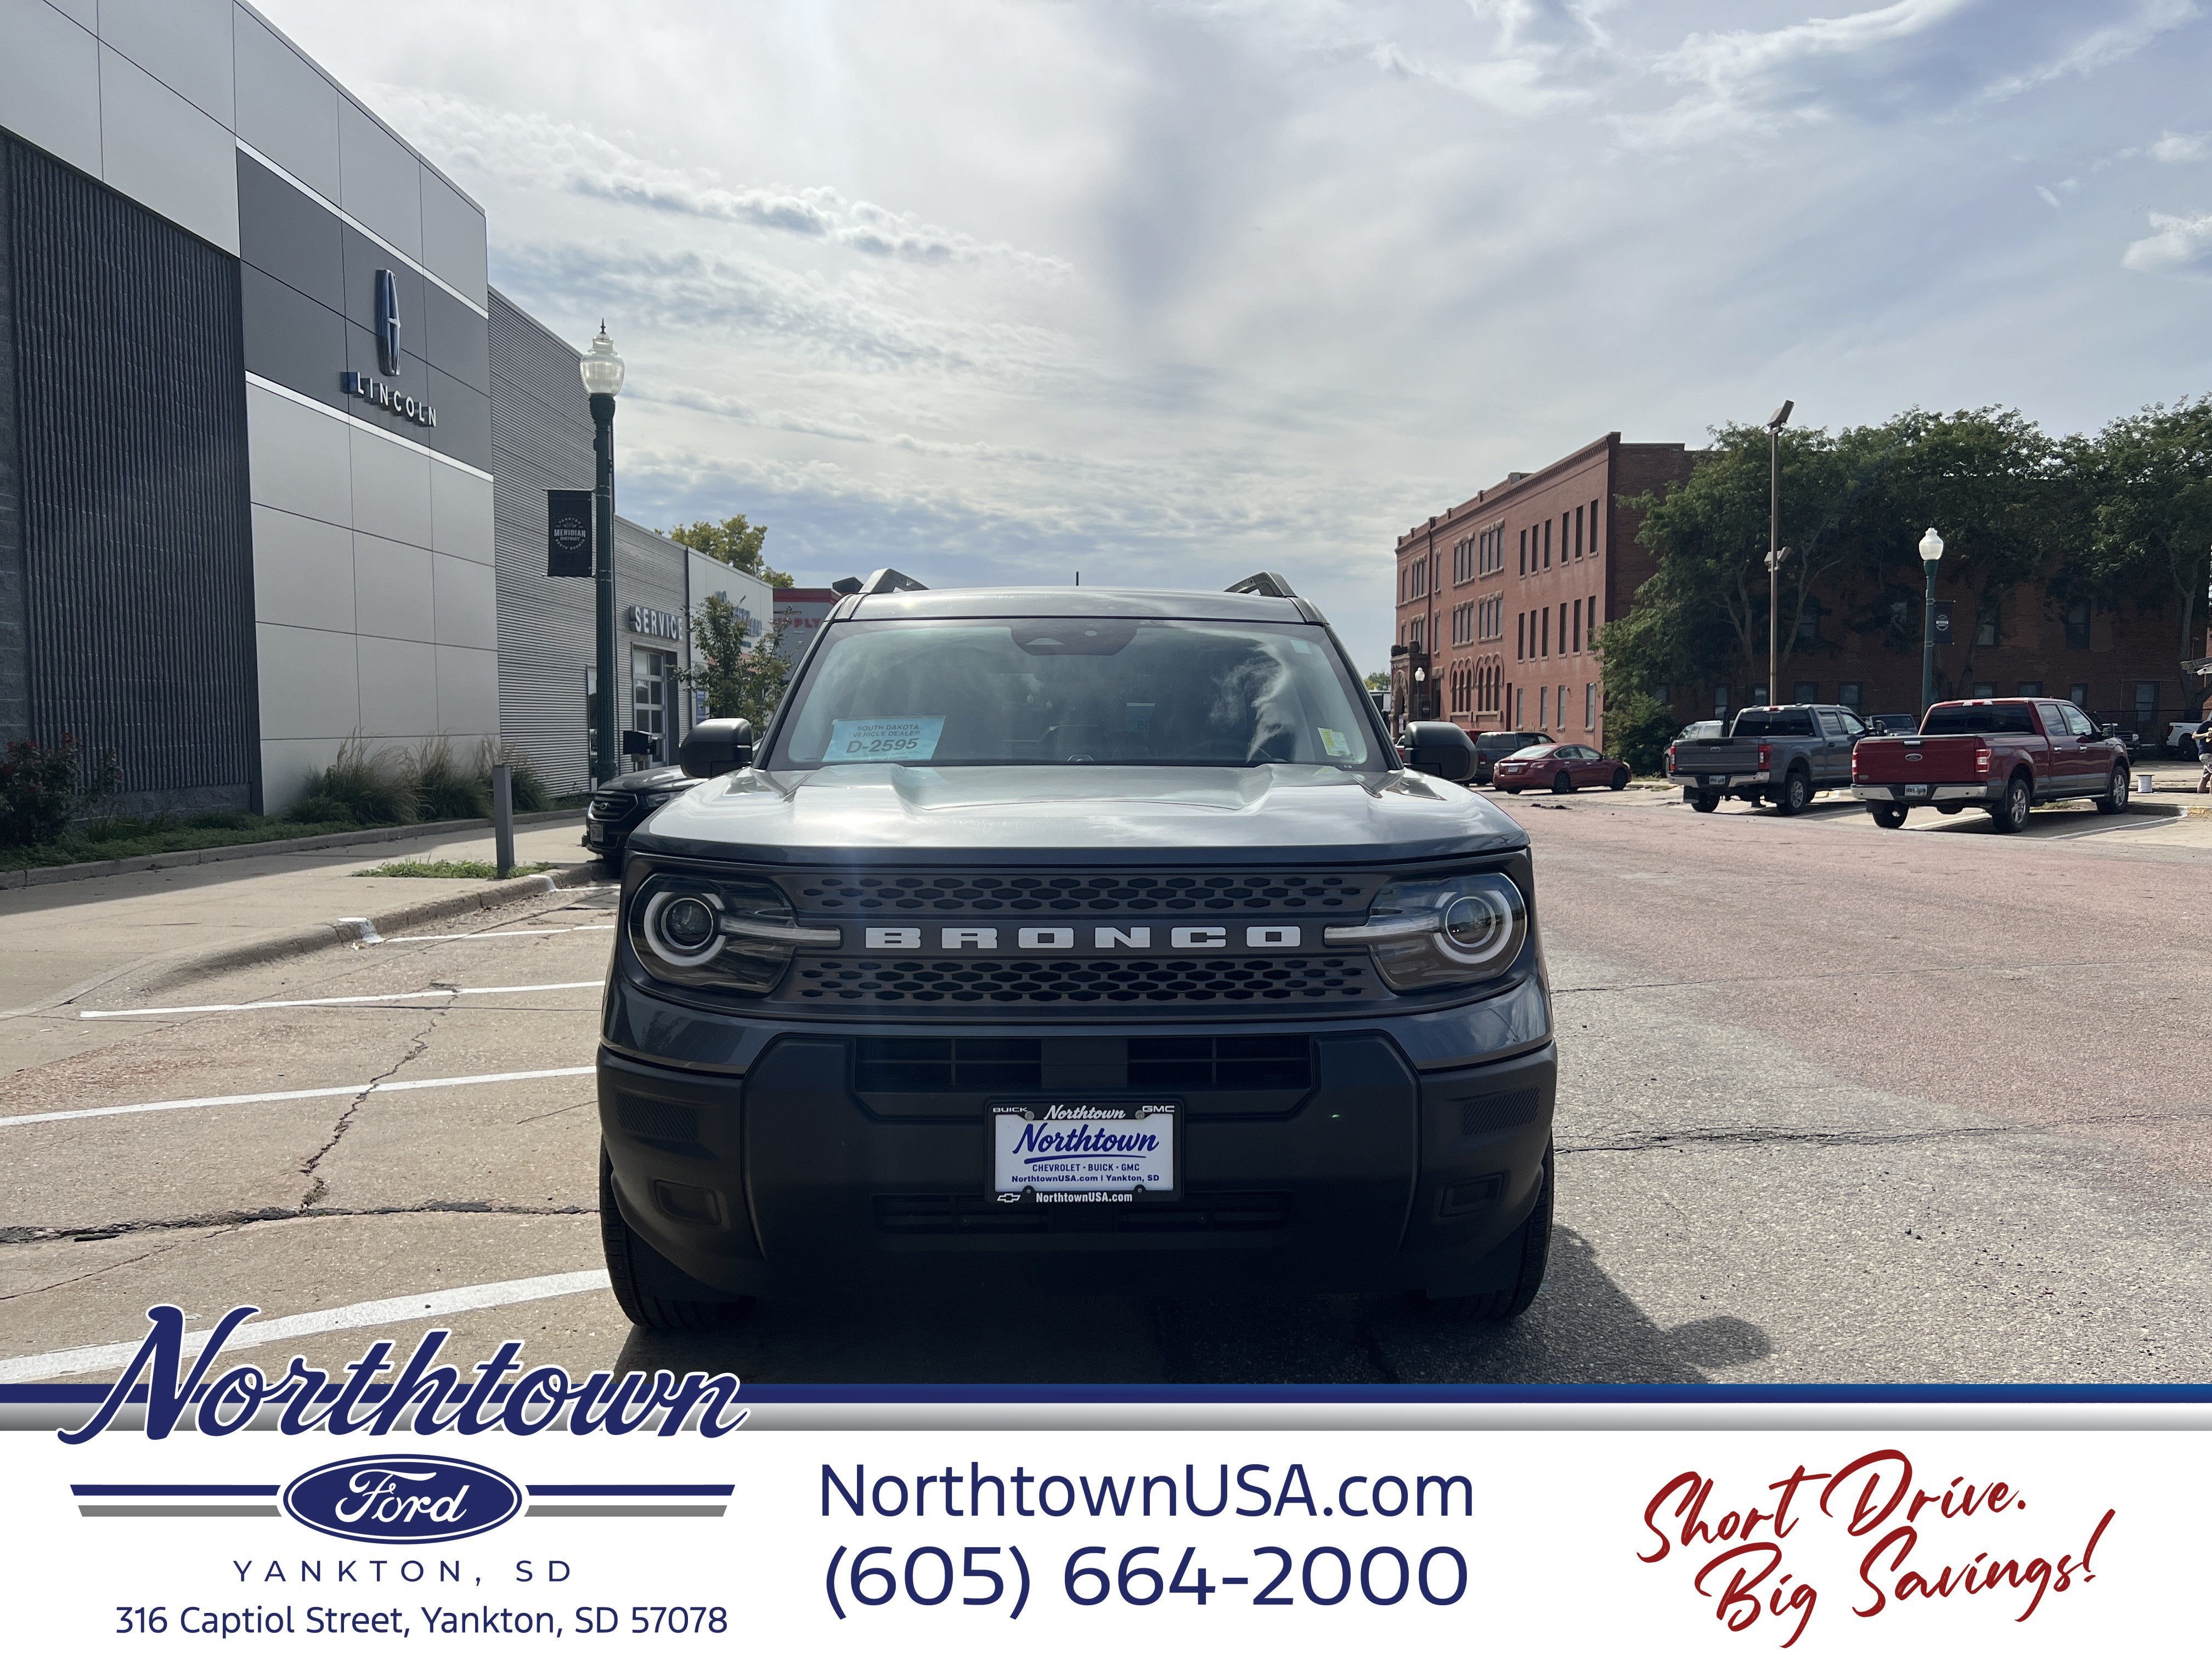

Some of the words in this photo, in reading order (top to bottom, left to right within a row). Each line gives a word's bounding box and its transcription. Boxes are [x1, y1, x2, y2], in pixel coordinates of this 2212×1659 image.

[357, 371, 436, 427] LINCOLN
[554, 529, 586, 538] MERIDIAN
[635, 606, 683, 640] SERVICE
[847, 738, 919, 753] D-2595
[866, 927, 1301, 949] BRONCO
[1043, 1104, 1126, 1120] Northtown
[1012, 1122, 1159, 1154] Northtown
[1032, 1164, 1081, 1172] CHEVROLET
[1106, 1175, 1144, 1183] Yankton,
[1036, 1192, 1132, 1203] NorthtownUSA.com
